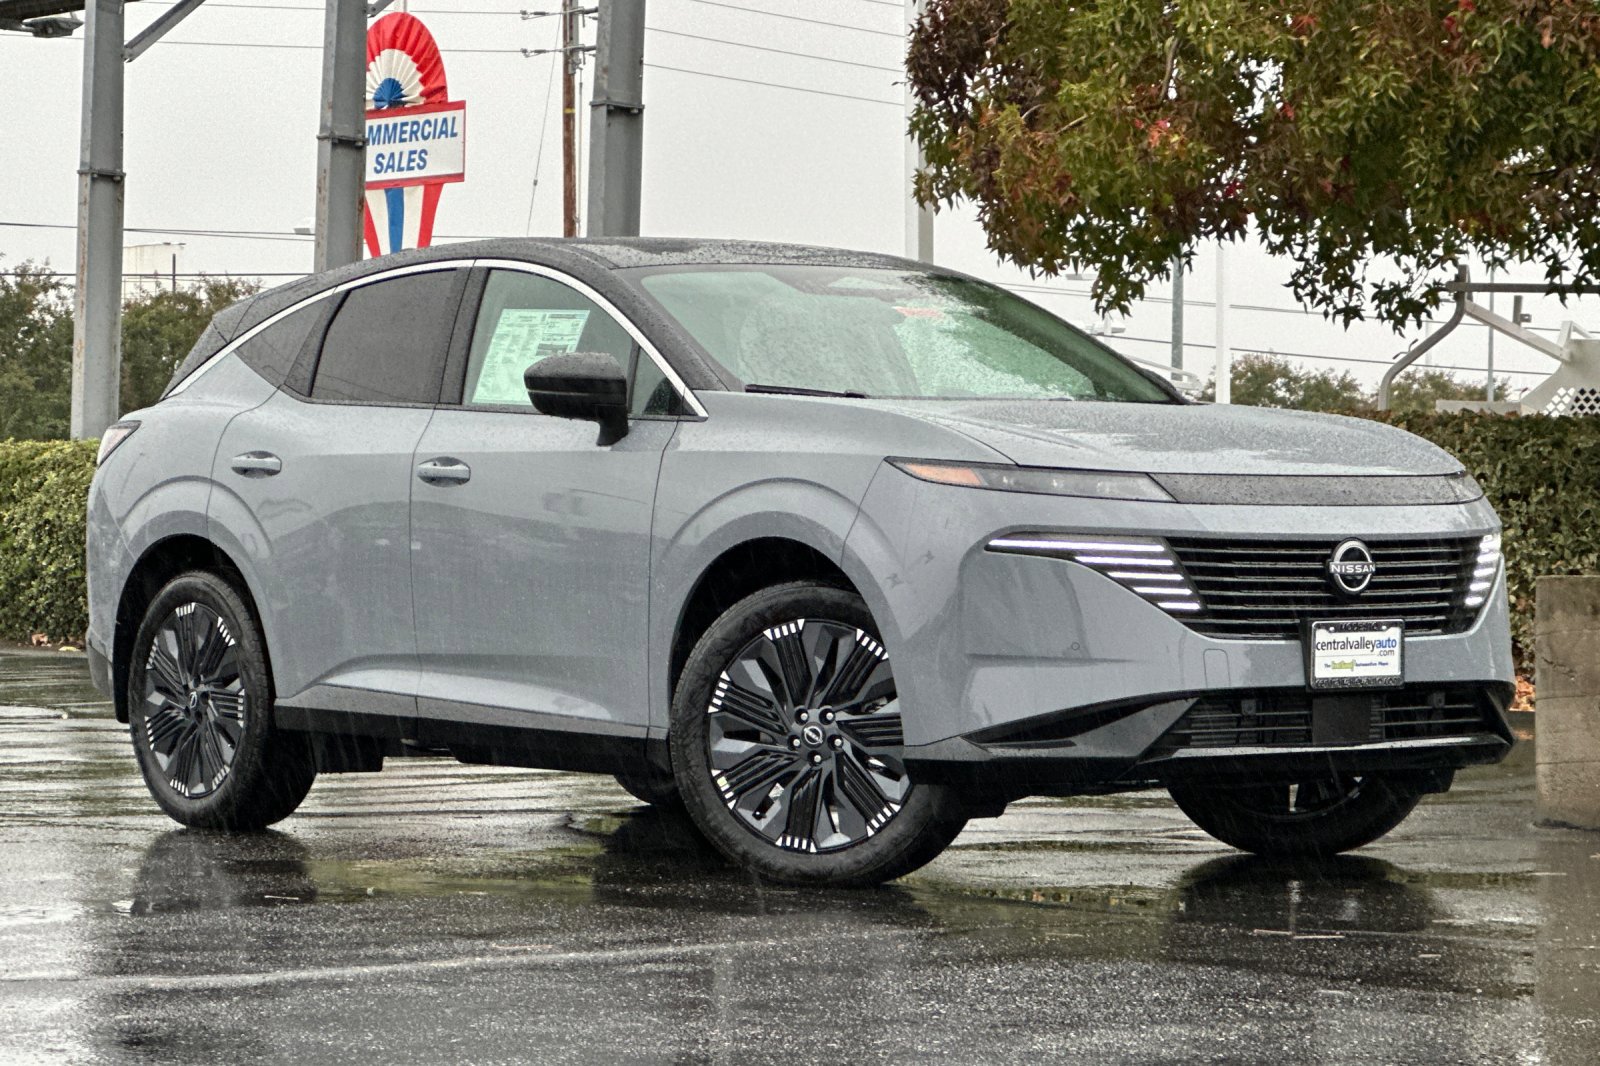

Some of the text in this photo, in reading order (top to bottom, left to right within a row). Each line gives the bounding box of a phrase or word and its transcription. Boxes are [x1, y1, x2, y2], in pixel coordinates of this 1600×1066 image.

[367, 116, 458, 146] MMERCIAL
[374, 149, 428, 174] SALES
[1331, 564, 1375, 573] NISSAN
[1316, 637, 1397, 652] centralvalleyauto
